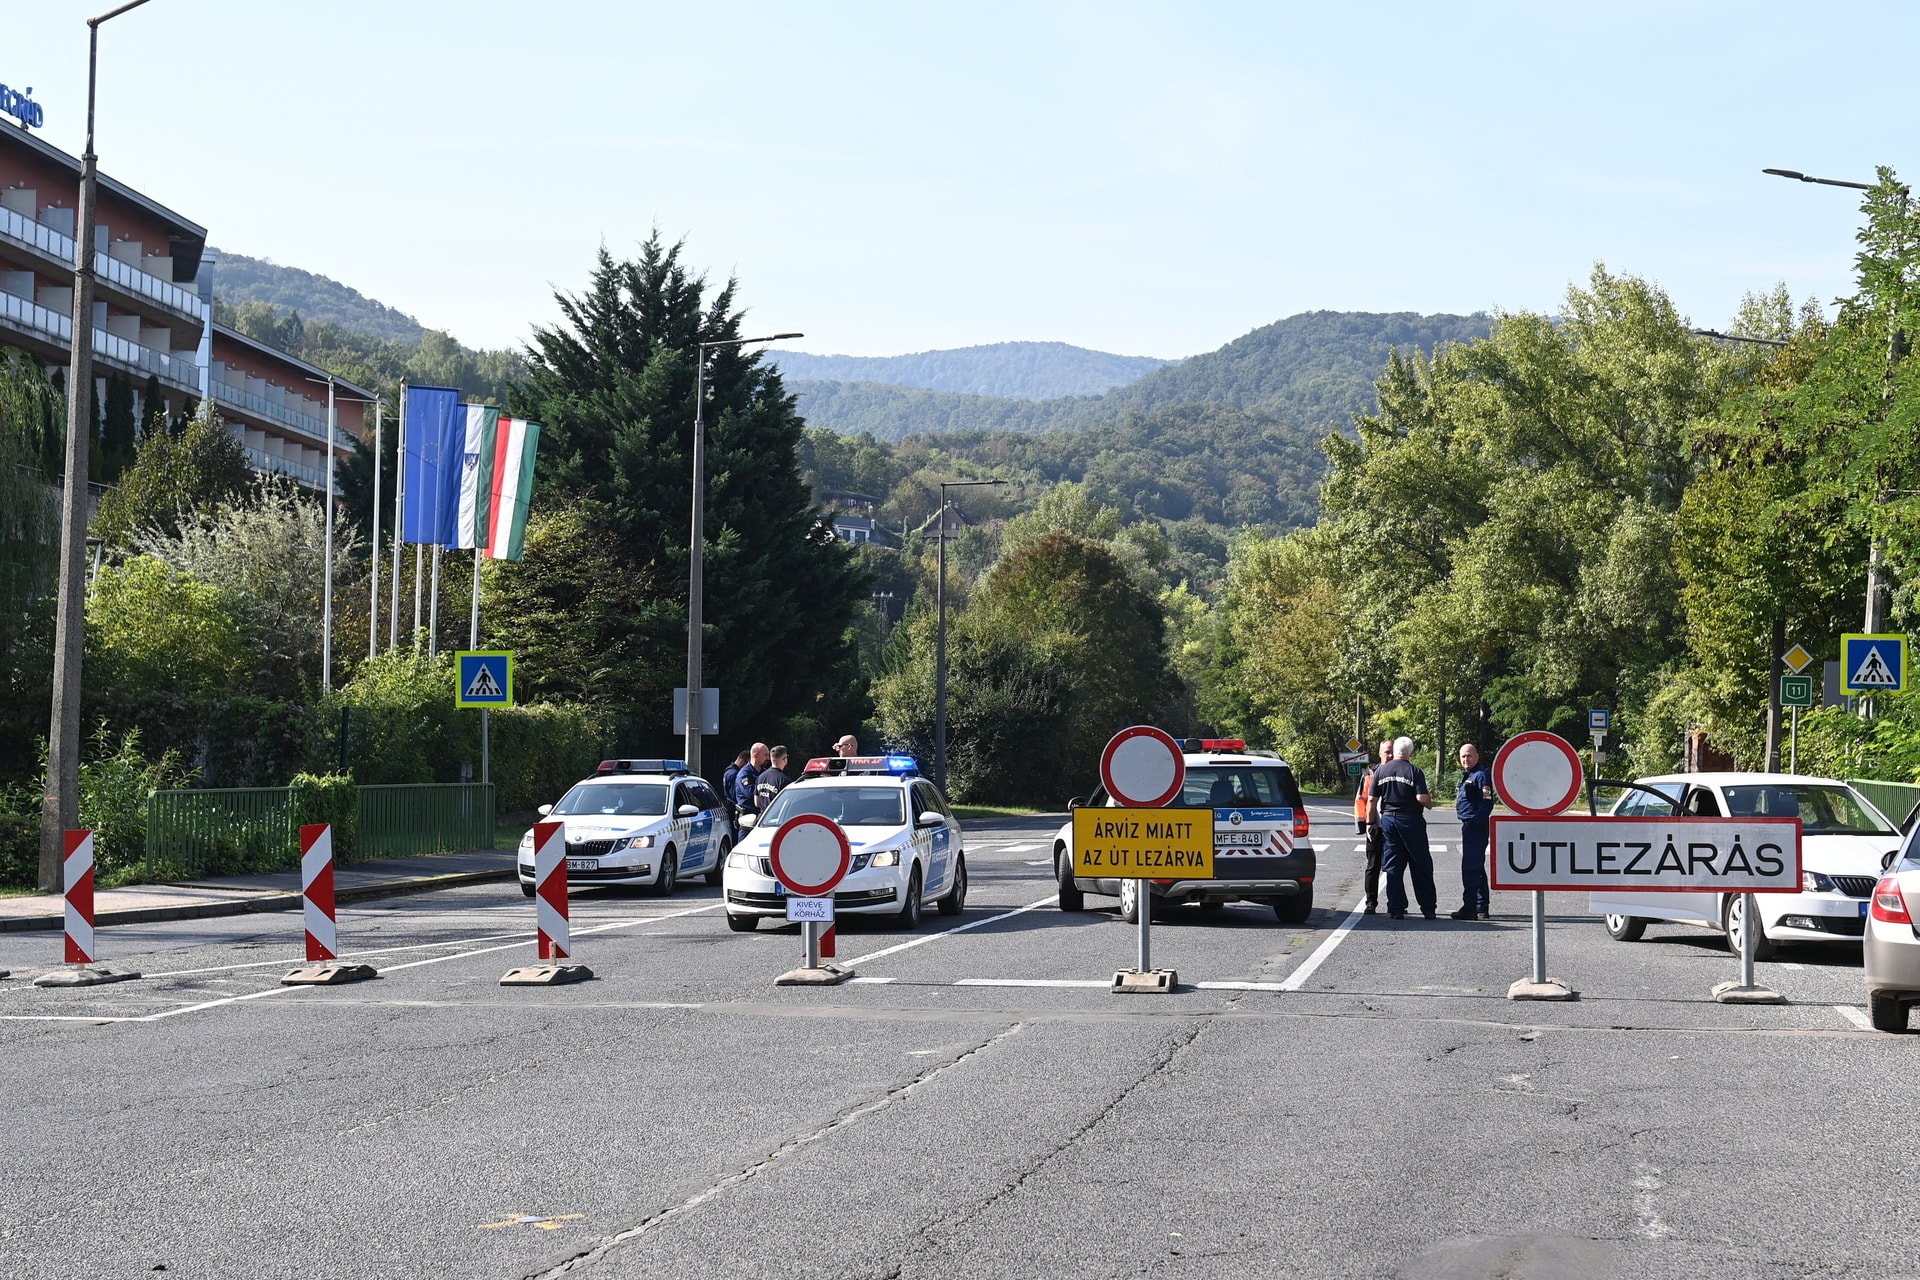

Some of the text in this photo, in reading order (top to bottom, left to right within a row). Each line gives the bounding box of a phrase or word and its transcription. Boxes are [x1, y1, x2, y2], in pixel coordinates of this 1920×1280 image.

[0, 82, 43, 128] EGRÁD
[1792, 686, 1801, 695] 11
[1094, 817, 1192, 839] ÁRVÍZ MIATT
[1216, 834, 1260, 844] MFE-848
[1083, 844, 1204, 867] AZ ÚT LEZÁRVA
[1508, 833, 1784, 876] ÚTLEZÁRÁS
[566, 861, 596, 869] BM-827
[796, 900, 823, 908] KIVÉVE
[794, 908, 825, 918] KÓRHÁZ
